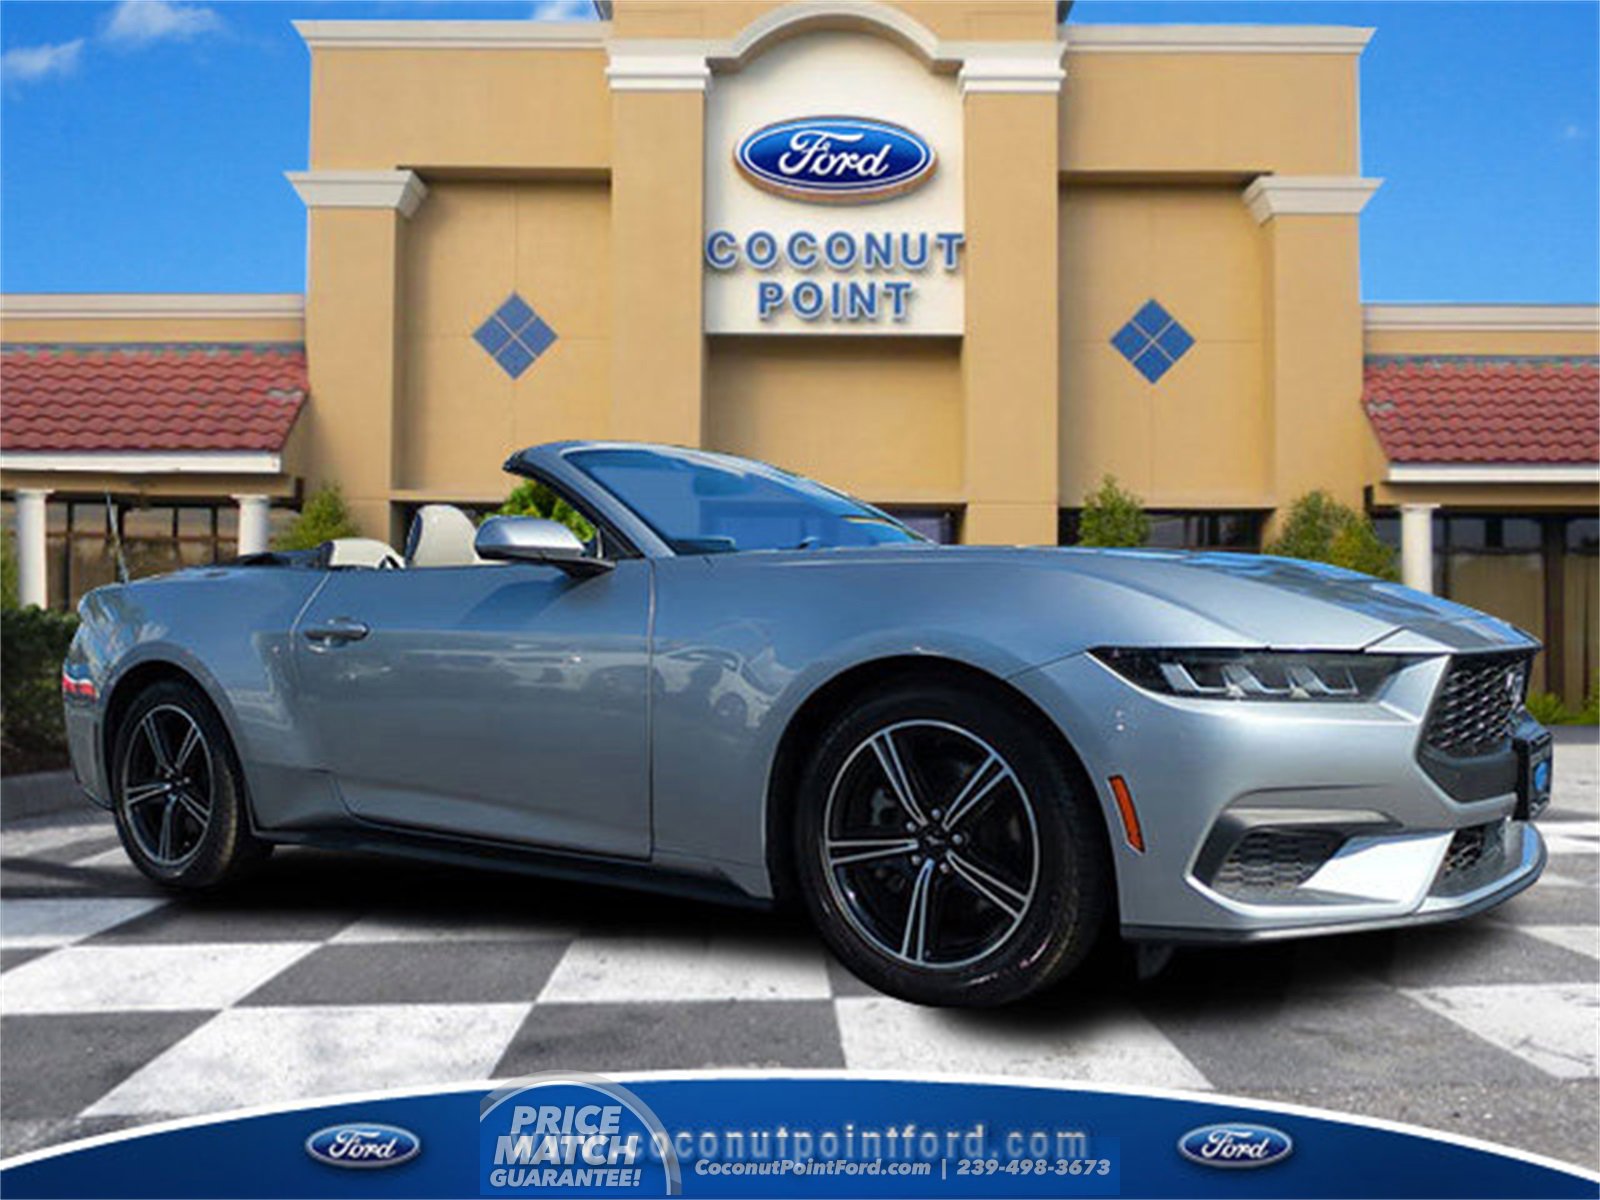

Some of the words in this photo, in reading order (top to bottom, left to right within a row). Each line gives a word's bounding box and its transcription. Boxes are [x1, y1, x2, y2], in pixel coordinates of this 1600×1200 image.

[778, 129, 892, 176] Ford
[705, 230, 965, 269] COCONUT
[757, 281, 912, 318] POINT
